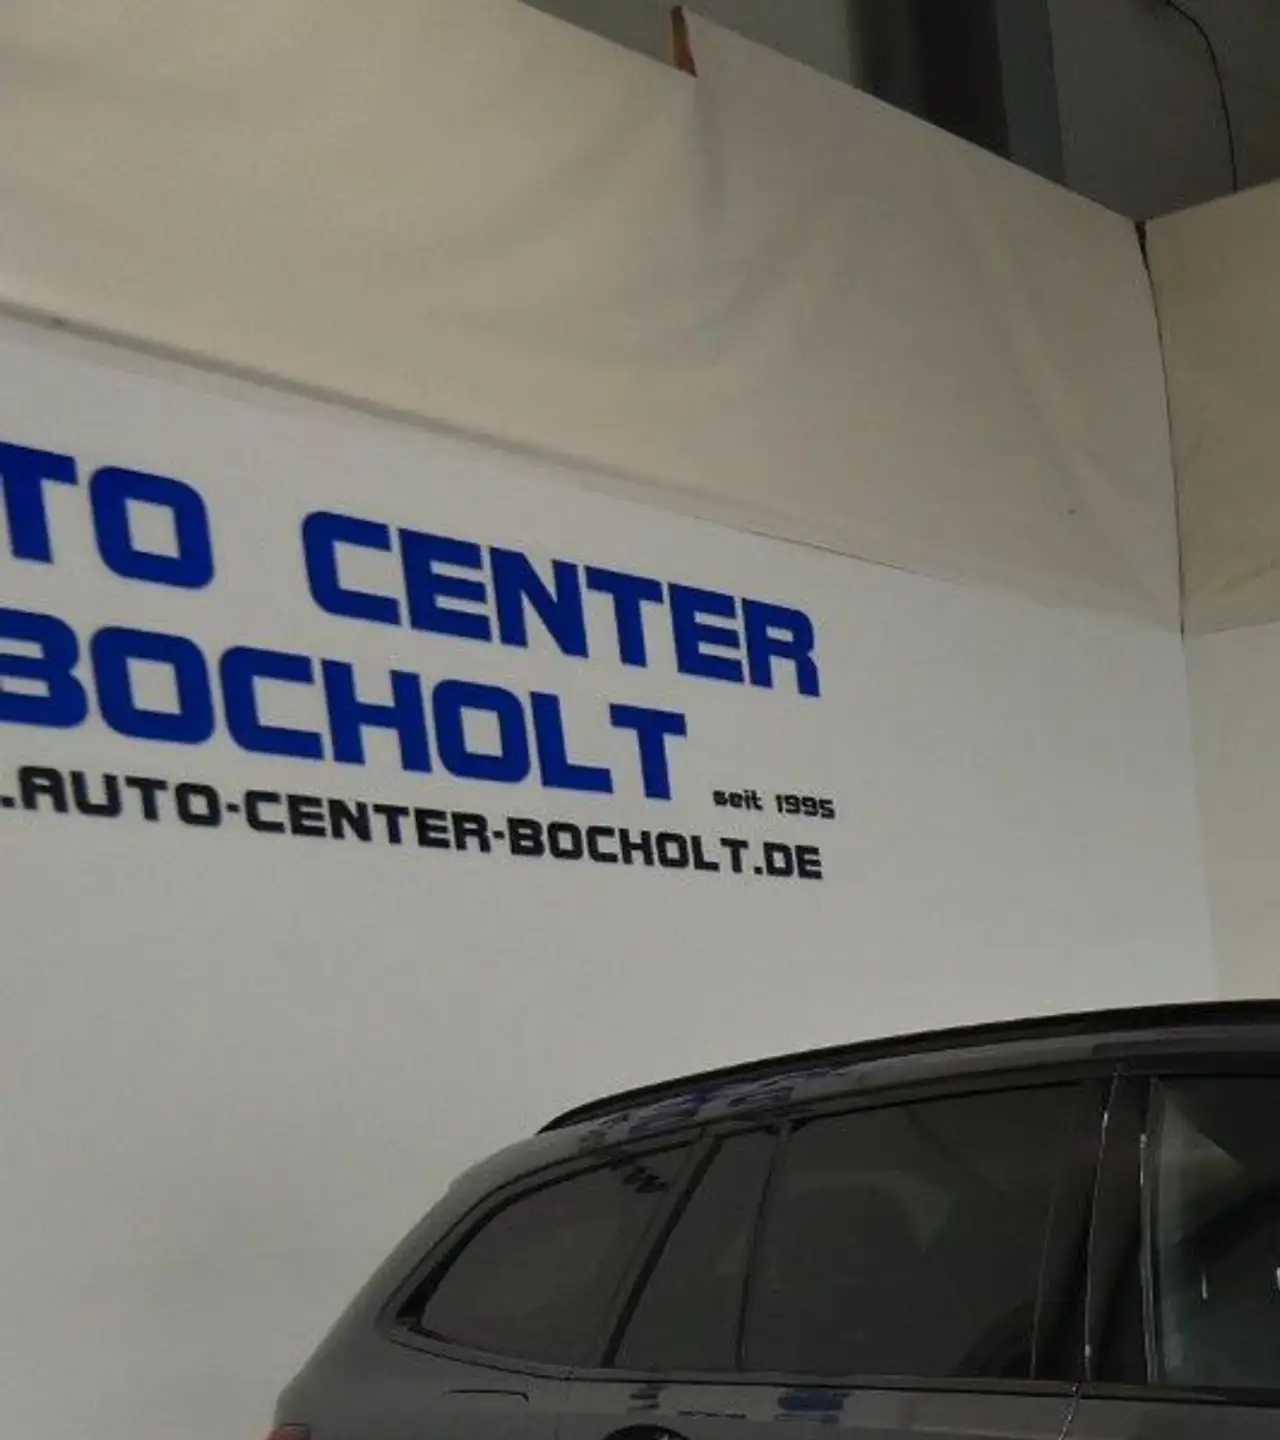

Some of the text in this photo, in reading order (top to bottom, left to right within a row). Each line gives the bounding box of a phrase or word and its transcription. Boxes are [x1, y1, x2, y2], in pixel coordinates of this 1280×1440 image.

[302, 510, 820, 697] CENTER
[0, 608, 687, 800] BOCHOLT
[712, 789, 836, 820] seit 1995
